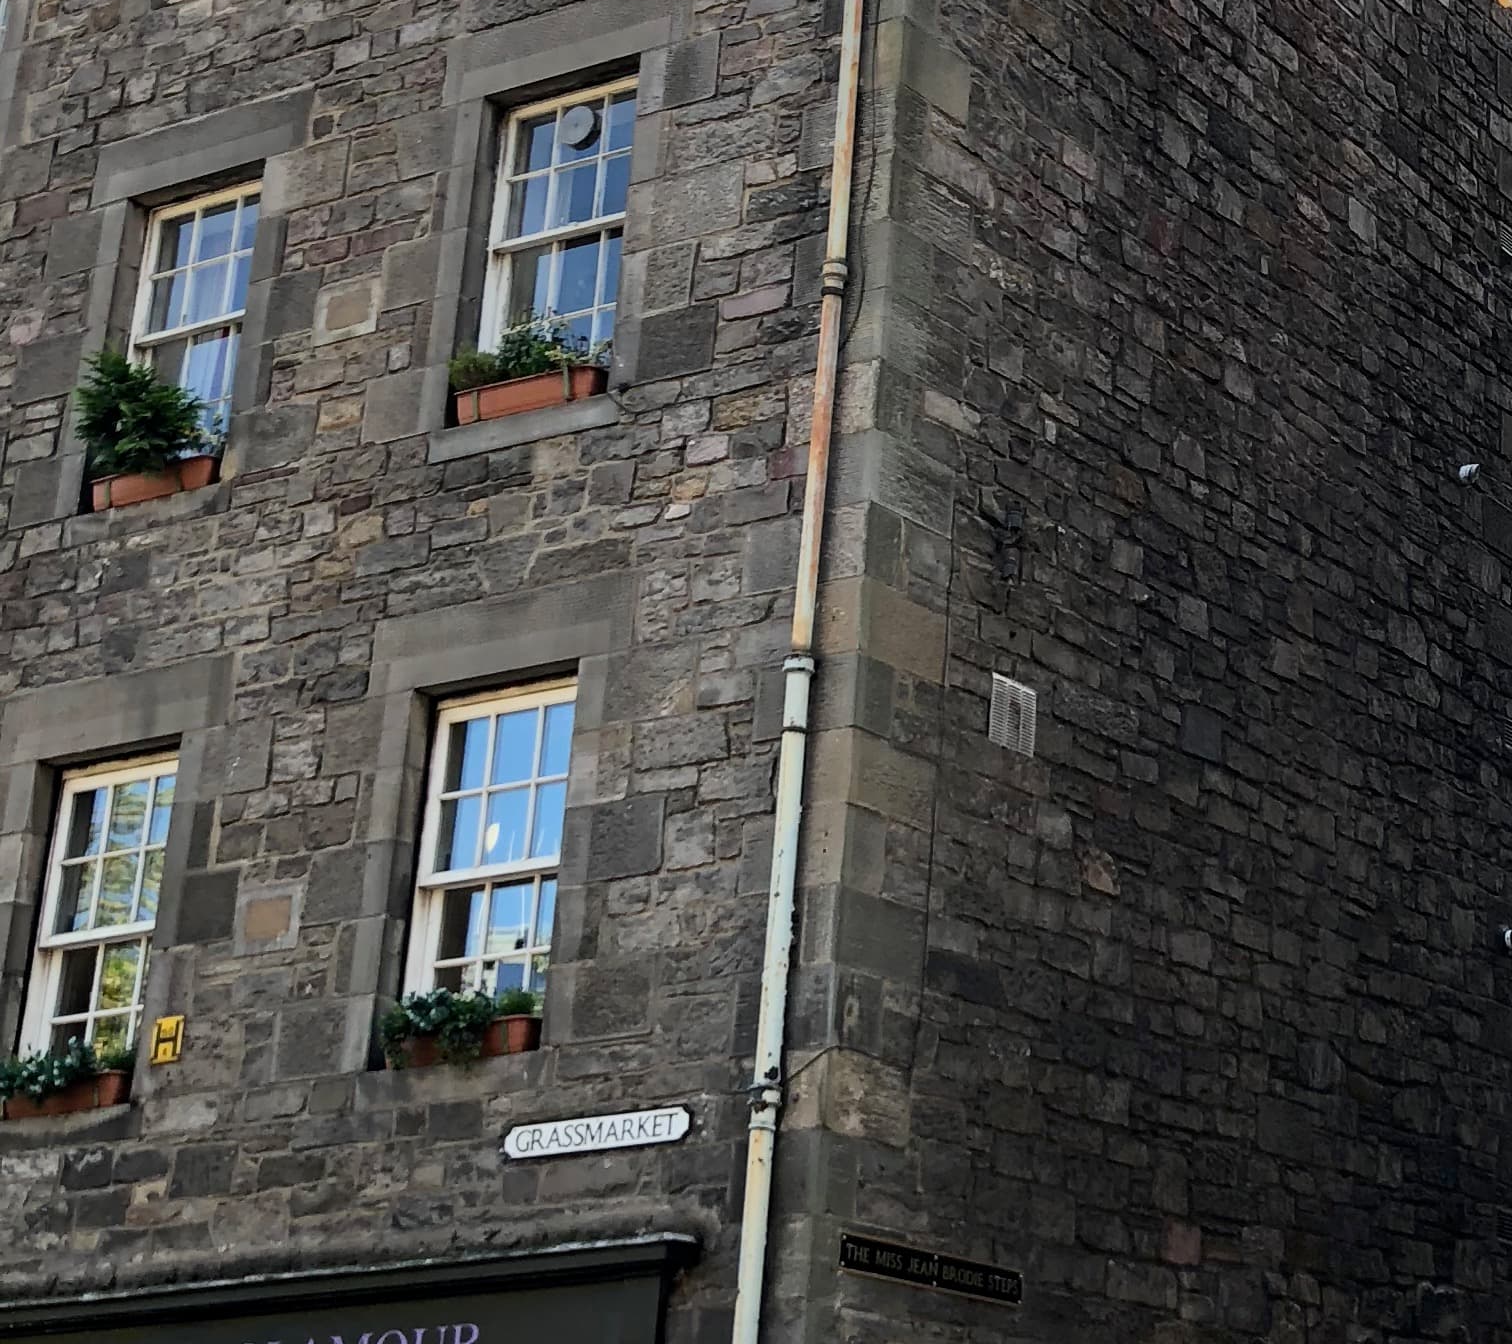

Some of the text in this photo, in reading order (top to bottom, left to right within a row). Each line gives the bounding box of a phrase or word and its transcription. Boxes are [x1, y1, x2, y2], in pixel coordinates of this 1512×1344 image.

[515, 1112, 678, 1153] GRASSMARKET
[847, 1243, 1018, 1295] THE MISS JEAN BRODIE STEPS
